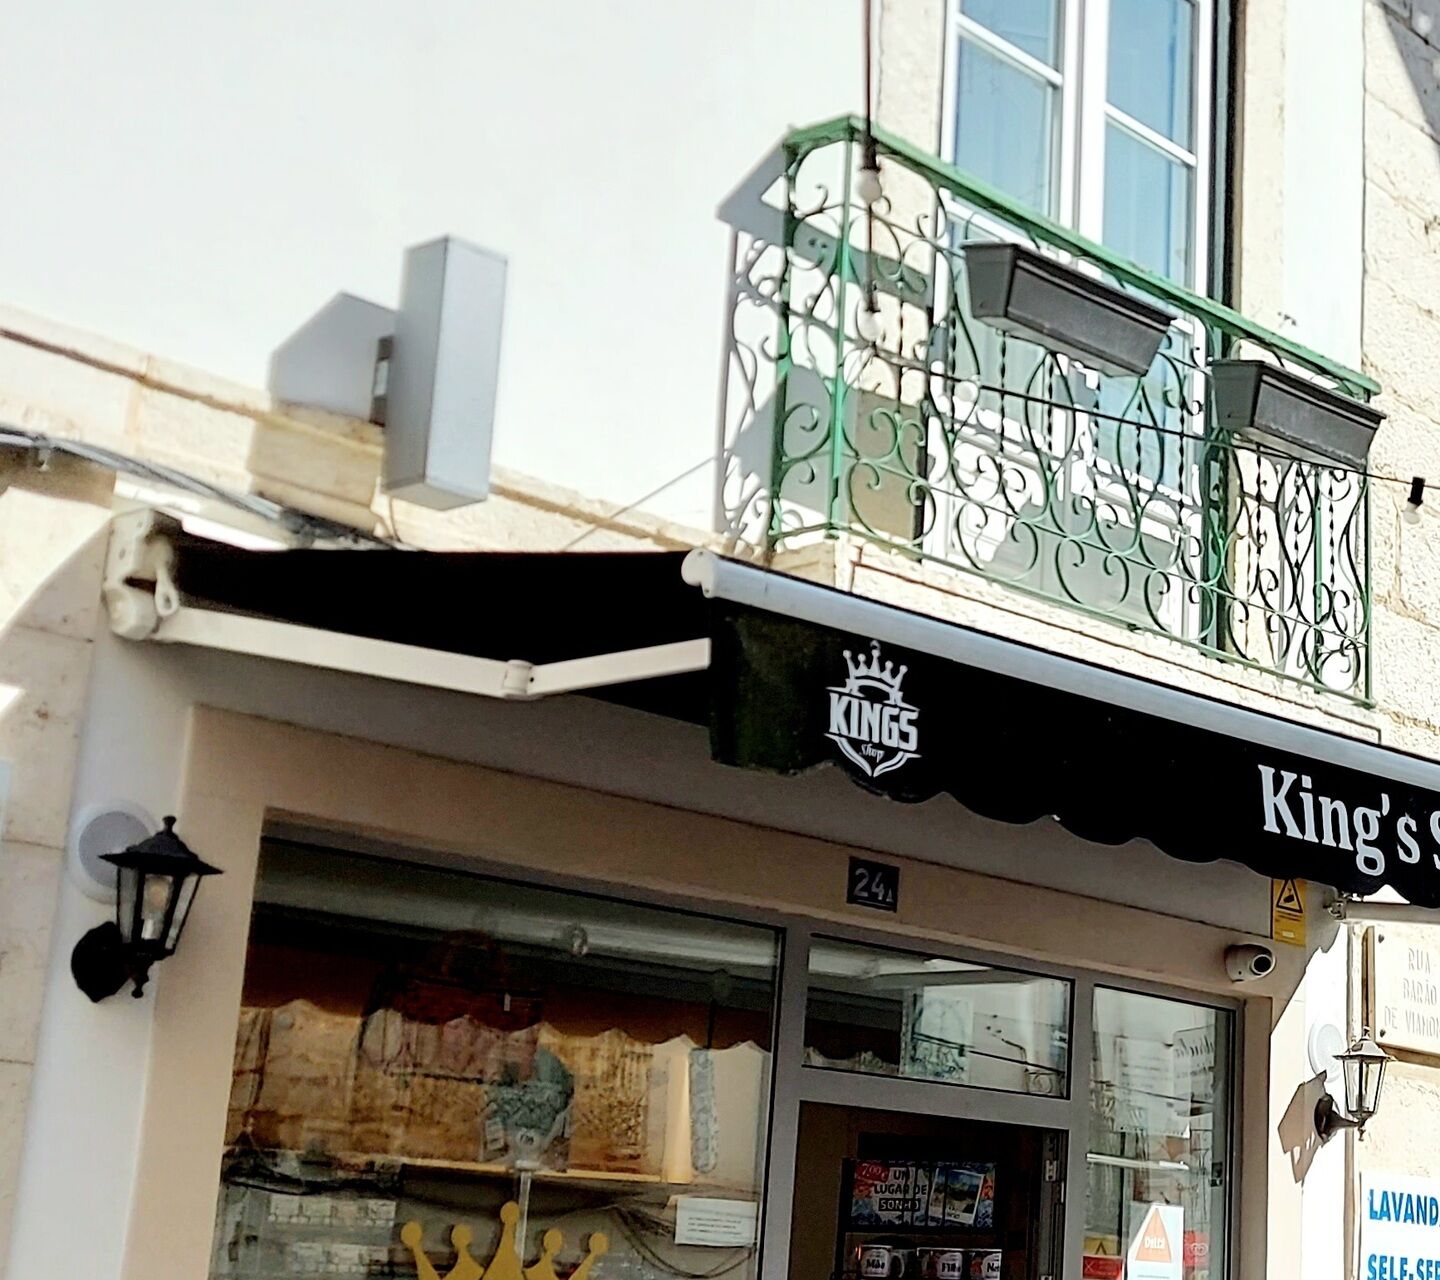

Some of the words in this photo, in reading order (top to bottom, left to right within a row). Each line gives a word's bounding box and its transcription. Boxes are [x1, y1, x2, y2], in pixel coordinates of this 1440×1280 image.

[829, 692, 919, 752] KINGS
[1258, 764, 1420, 876] King's
[1408, 947, 1431, 974] RUA
[1403, 978, 1437, 1006] BARÃO
[1384, 1005, 1398, 1030] DE
